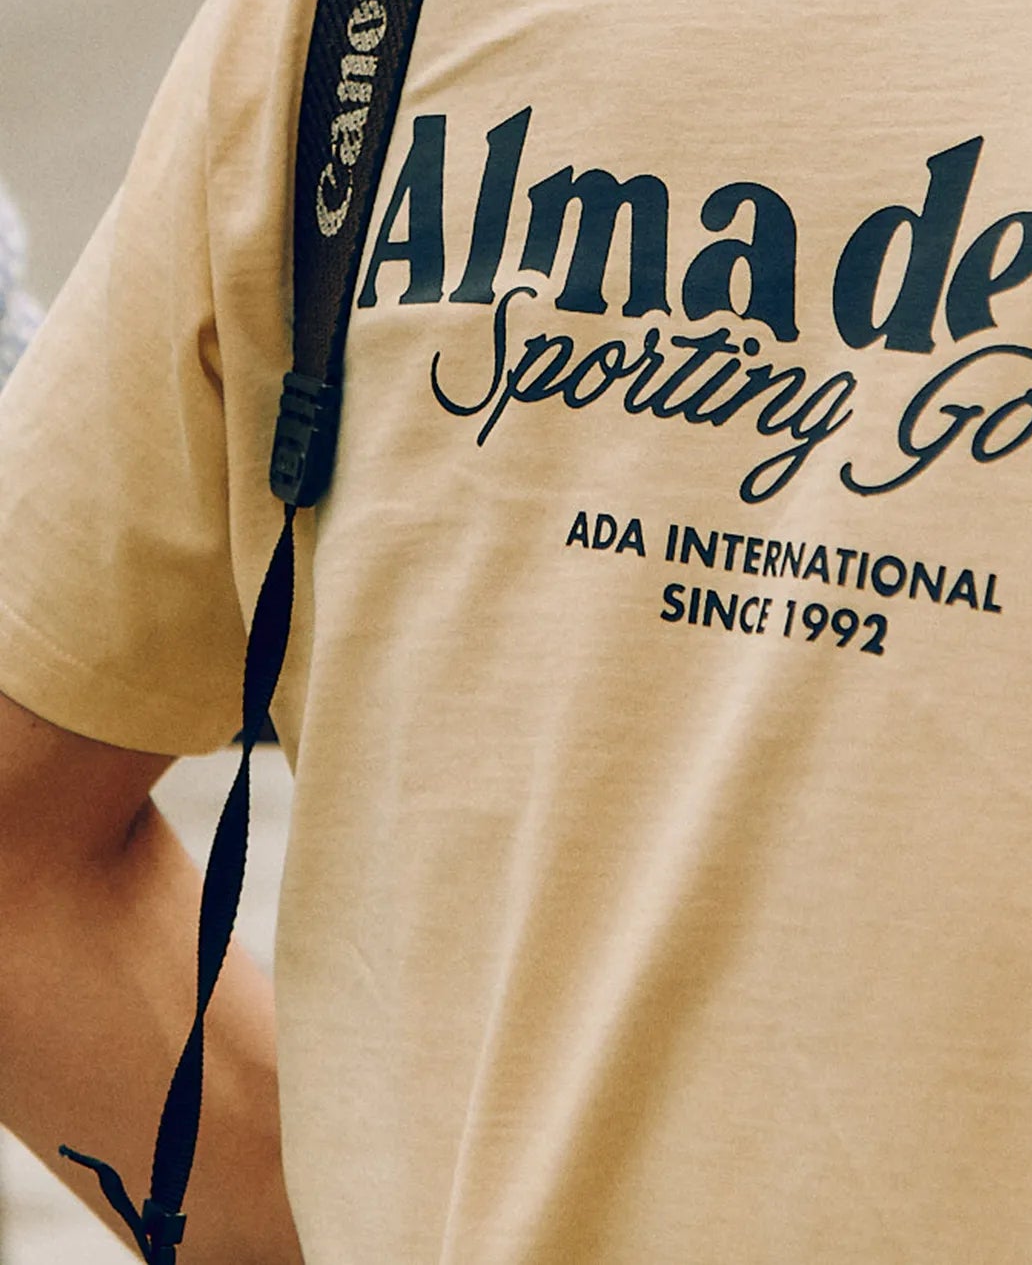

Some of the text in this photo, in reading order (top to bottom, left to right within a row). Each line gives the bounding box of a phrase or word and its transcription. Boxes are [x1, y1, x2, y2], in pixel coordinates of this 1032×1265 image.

[357, 105, 801, 344] Alma
[431, 286, 857, 505] Sporting
[565, 510, 1003, 614] ADA INTERNATIONAL
[660, 582, 889, 656] SINCE 1992
